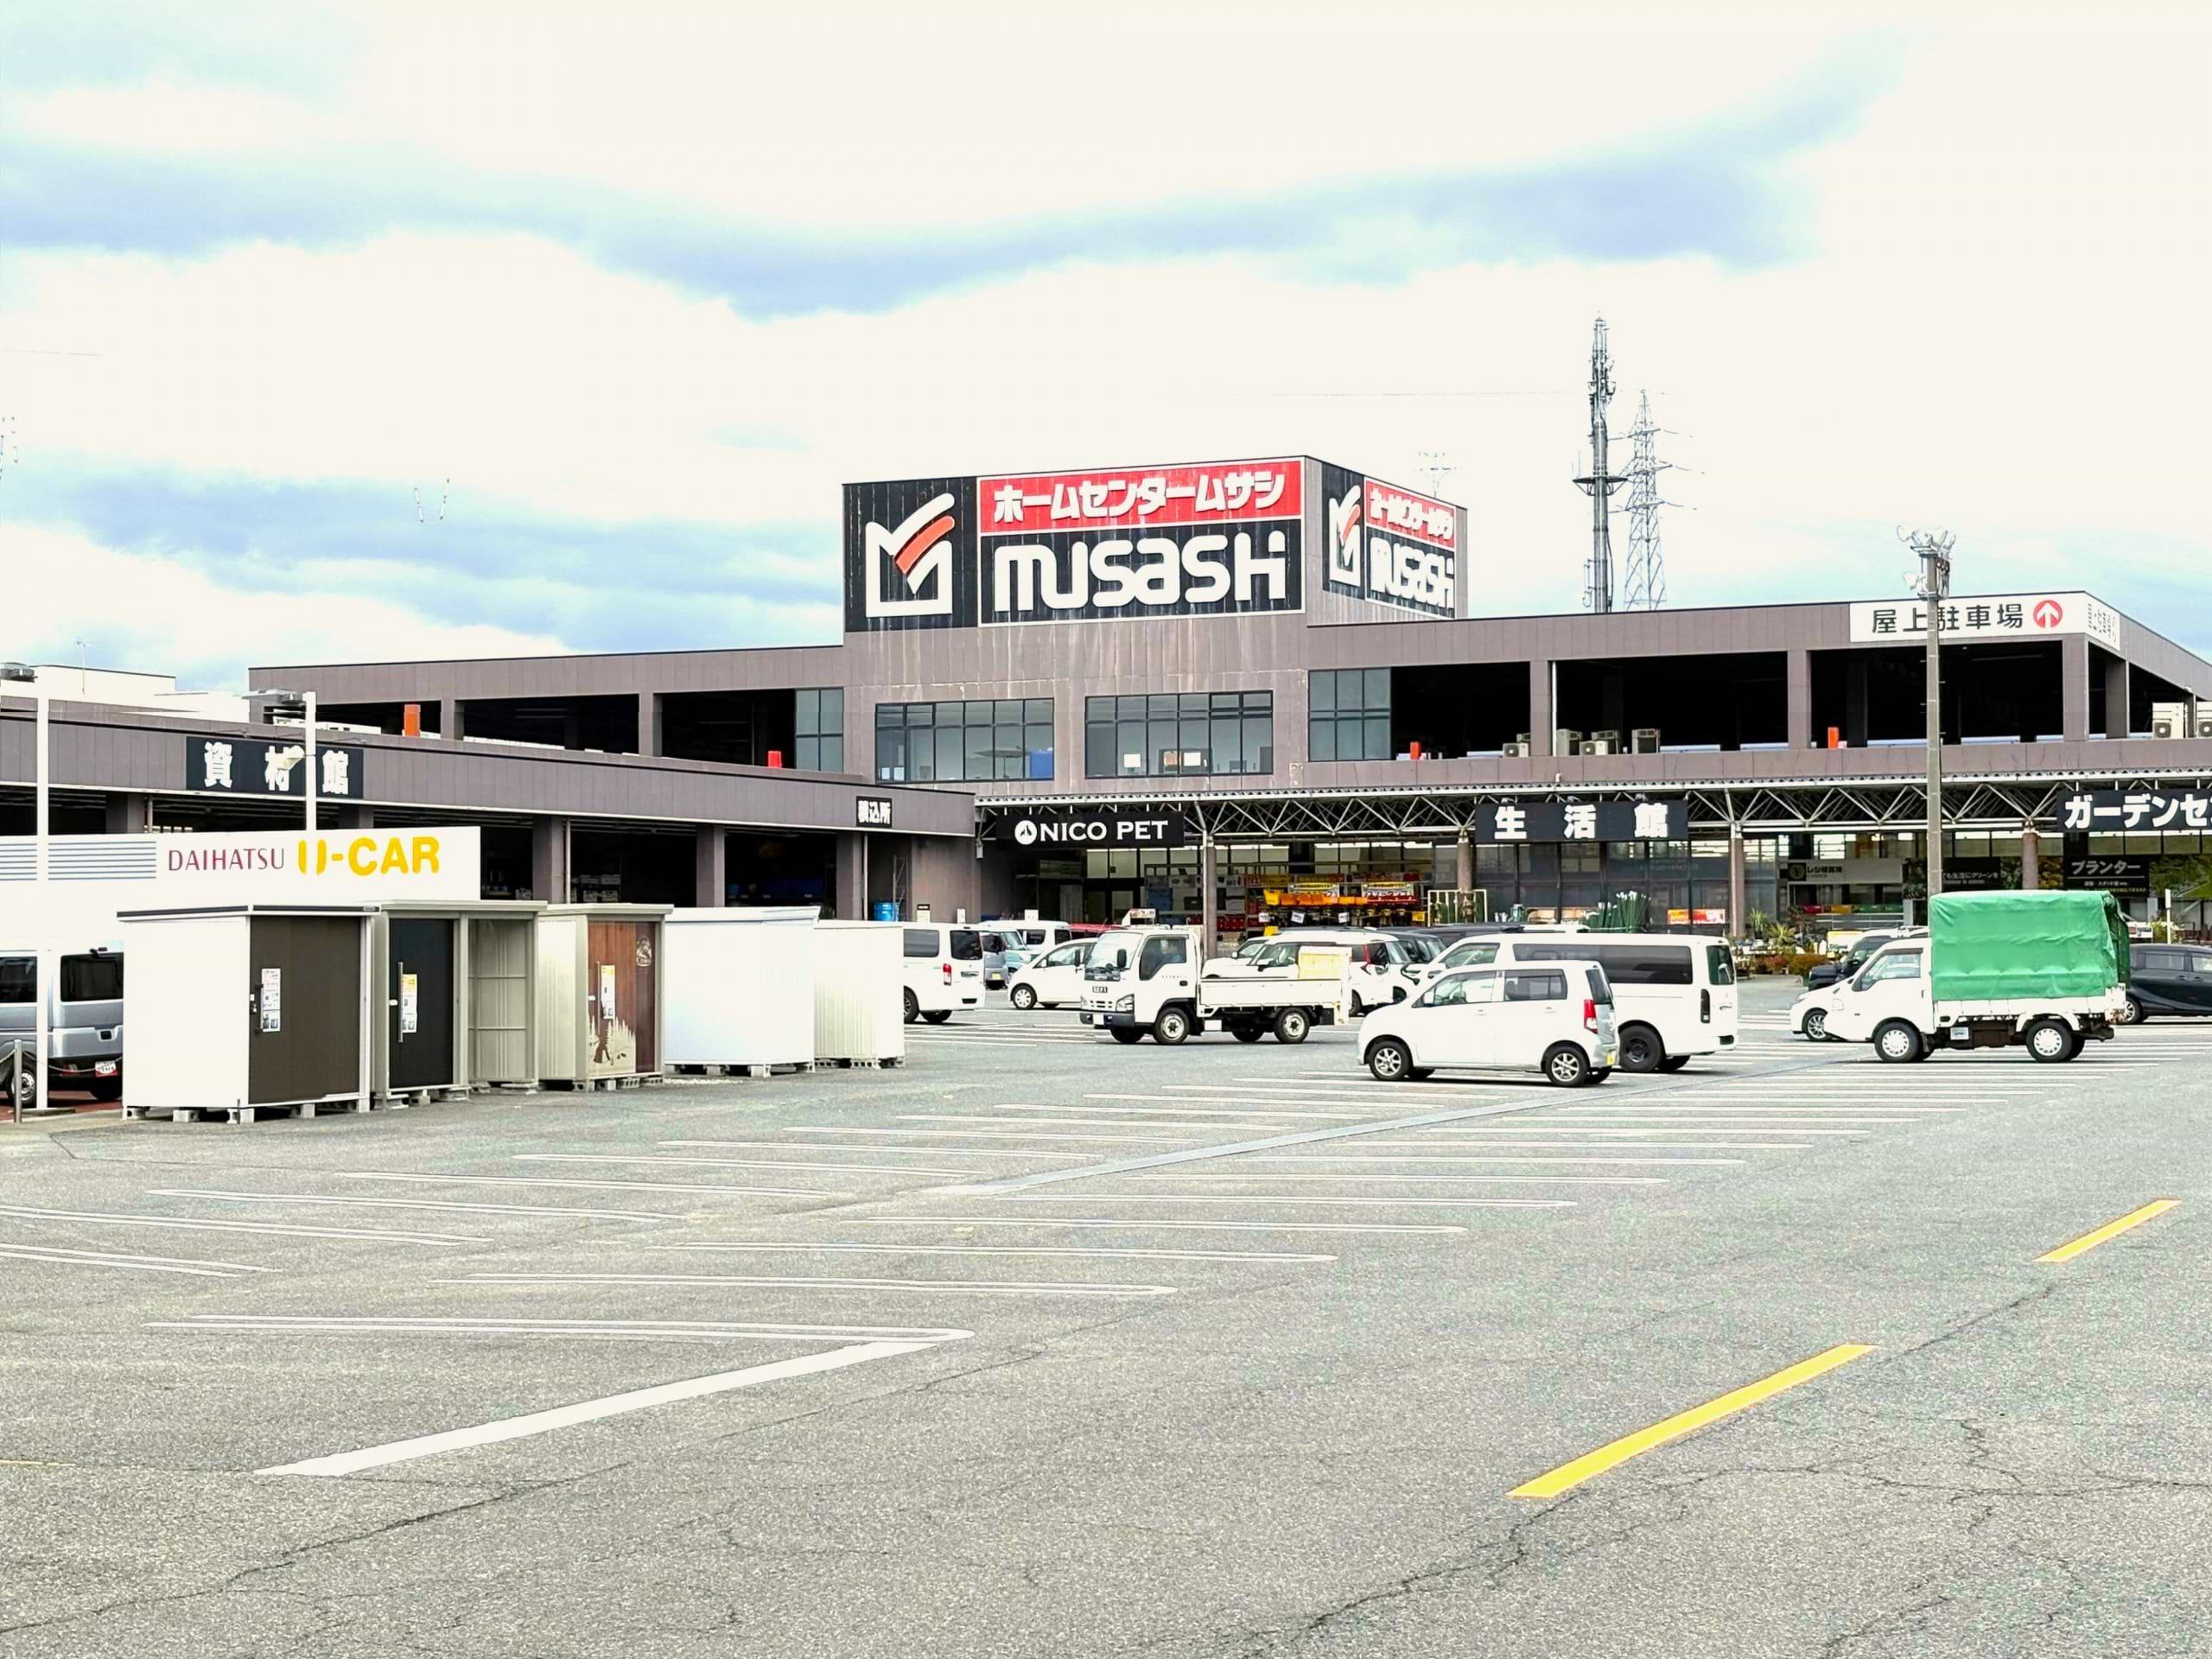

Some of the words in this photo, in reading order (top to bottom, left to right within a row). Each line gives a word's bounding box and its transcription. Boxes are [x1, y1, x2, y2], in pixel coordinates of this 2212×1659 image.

[993, 471, 1286, 523] ホームセンタームサシ
[1872, 603, 2024, 634] 屋上駐車場
[203, 741, 349, 795] 資材館
[1039, 821, 1107, 841] NICO
[1116, 819, 1168, 840] PET
[1494, 803, 1669, 841] 生活館
[2063, 793, 2212, 830] ガーデンセ
[168, 848, 285, 872] DAIHATSU
[297, 836, 440, 876] U-CAR
[2071, 860, 2140, 874] プランター
